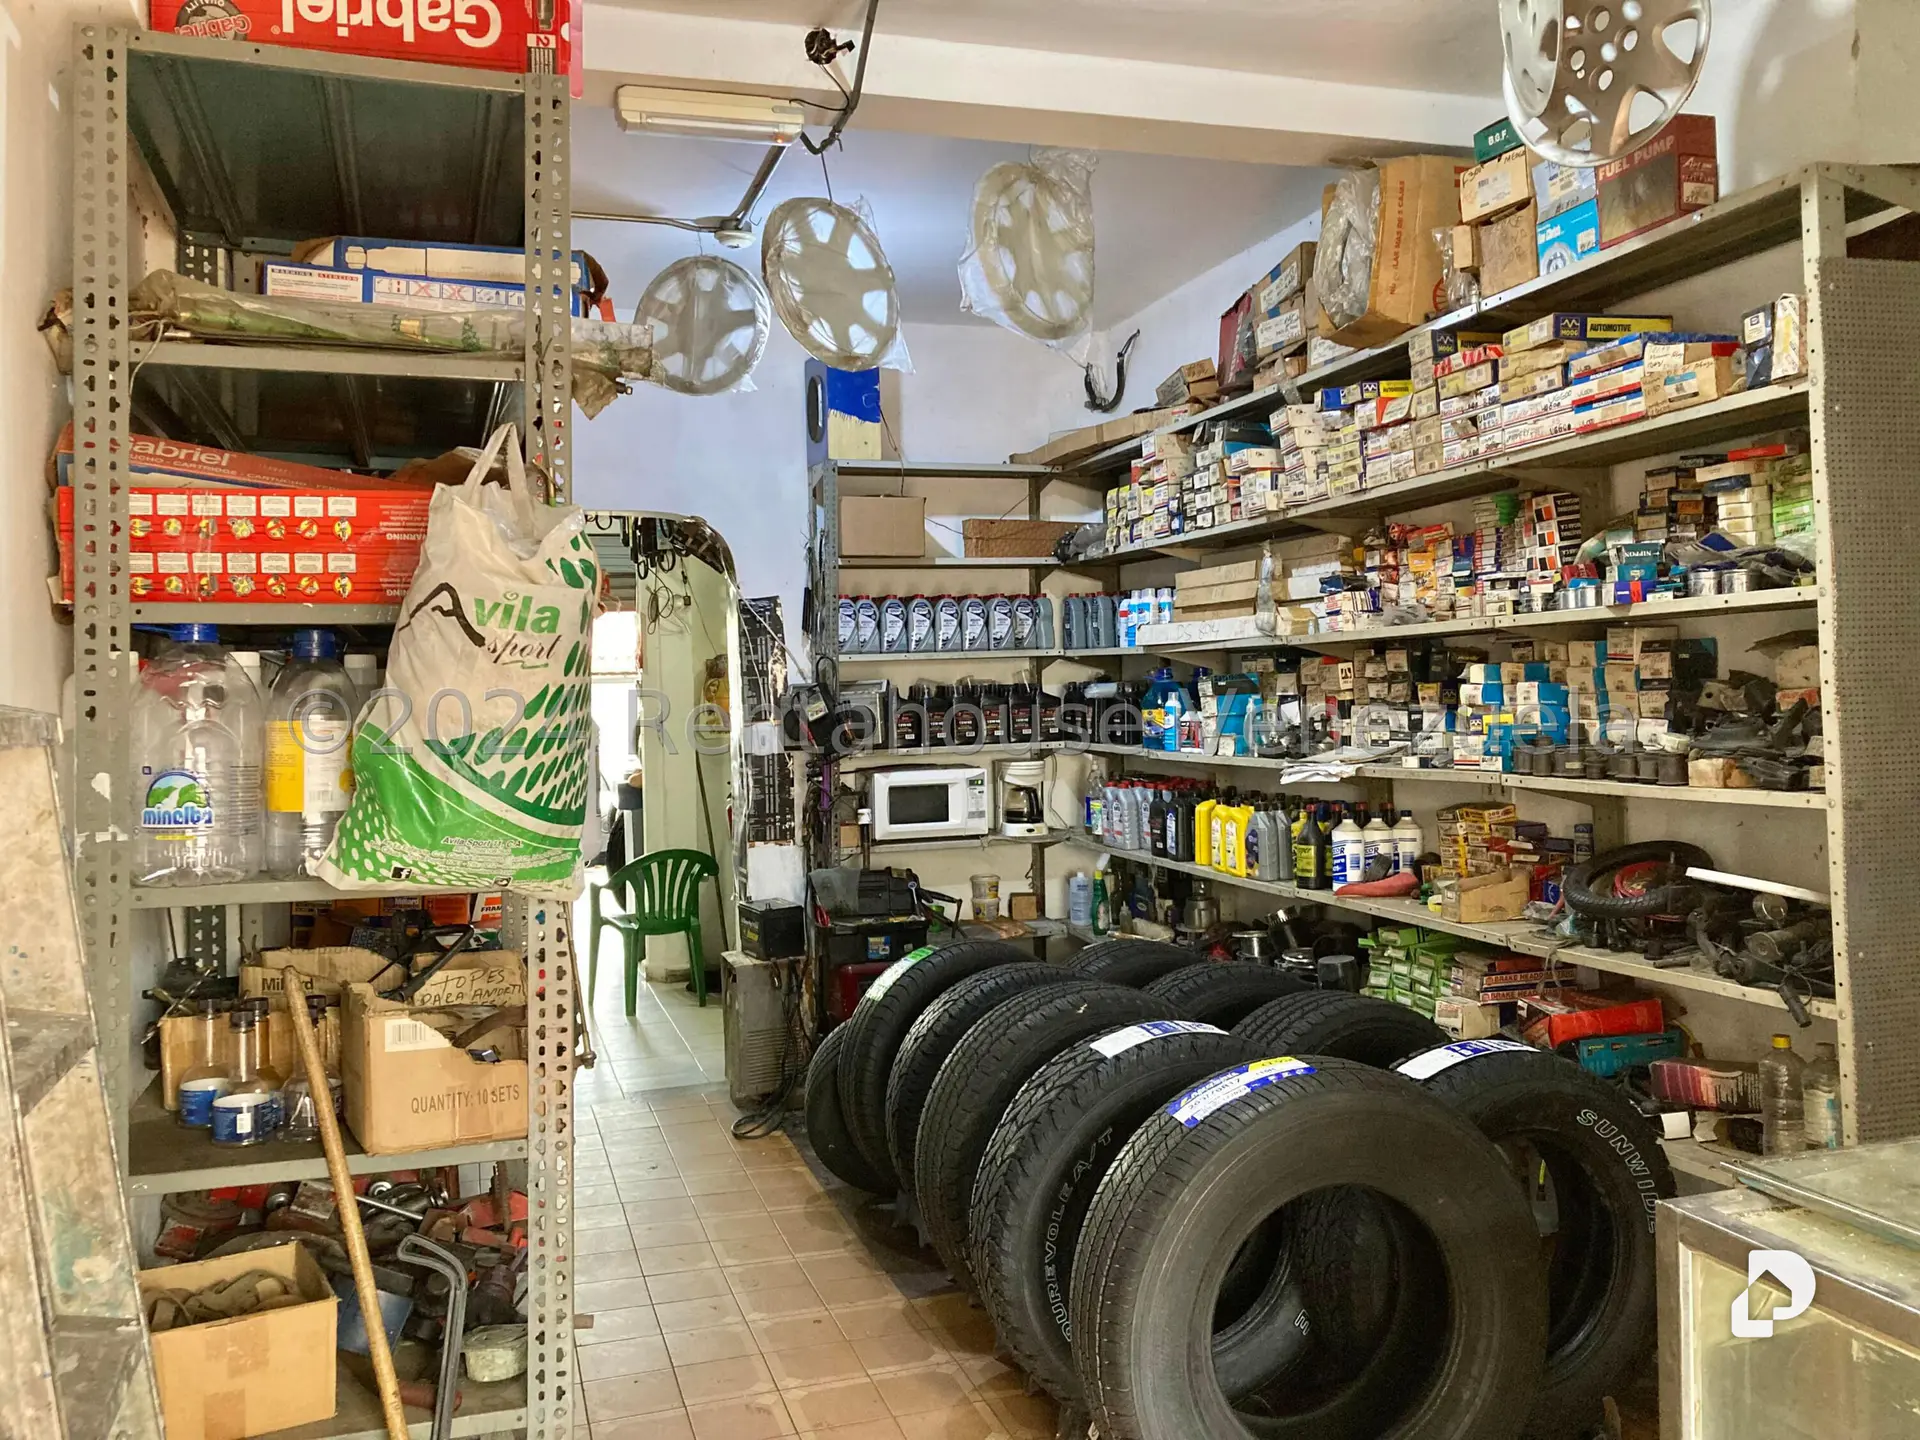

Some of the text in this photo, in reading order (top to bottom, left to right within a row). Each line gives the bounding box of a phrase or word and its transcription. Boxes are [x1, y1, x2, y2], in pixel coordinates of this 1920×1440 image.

[281, 0, 502, 48] Gabriel
[1598, 135, 1676, 181] FUEL PUMP
[1560, 328, 1579, 337] MOOG
[1589, 323, 1632, 333] AUTOMOTIVE
[129, 453, 164, 464] UCHO
[173, 460, 238, 476] CARTRIDGE
[487, 633, 562, 664] sport
[480, 905, 502, 913] FRAM
[262, 977, 314, 991] Mild
[1494, 973, 1518, 985] BRAKE
[1490, 990, 1512, 1001] BRAKE
[411, 1083, 521, 1115] QUANTITY: 10 SETS
[1073, 1127, 1113, 1182] A/T
